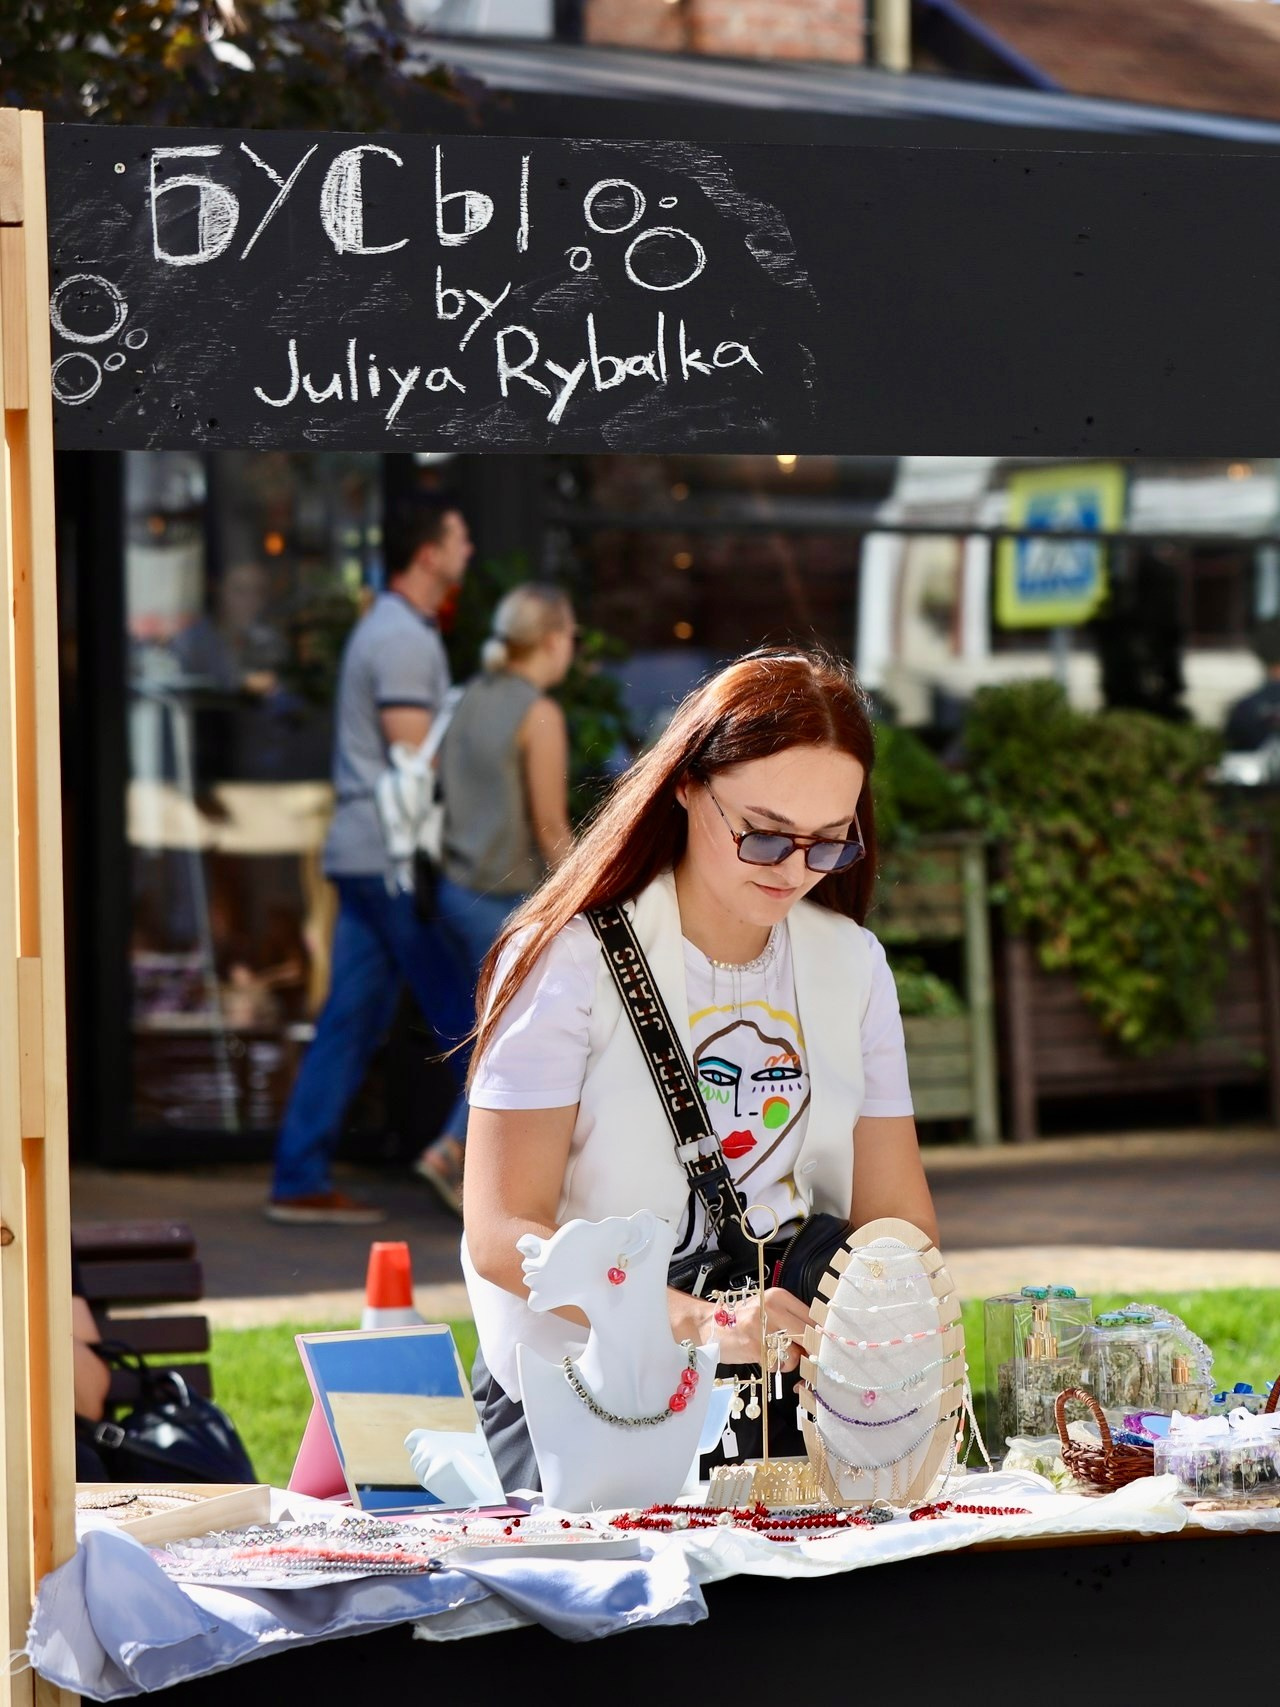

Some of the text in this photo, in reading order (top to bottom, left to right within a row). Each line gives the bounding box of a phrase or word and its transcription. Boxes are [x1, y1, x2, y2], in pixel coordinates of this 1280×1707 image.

[147, 141, 532, 266] БУСЫ
[436, 264, 512, 352] by
[253, 310, 764, 432] Juliya Rybalka
[612, 946, 695, 1113] PEPE JEANS
